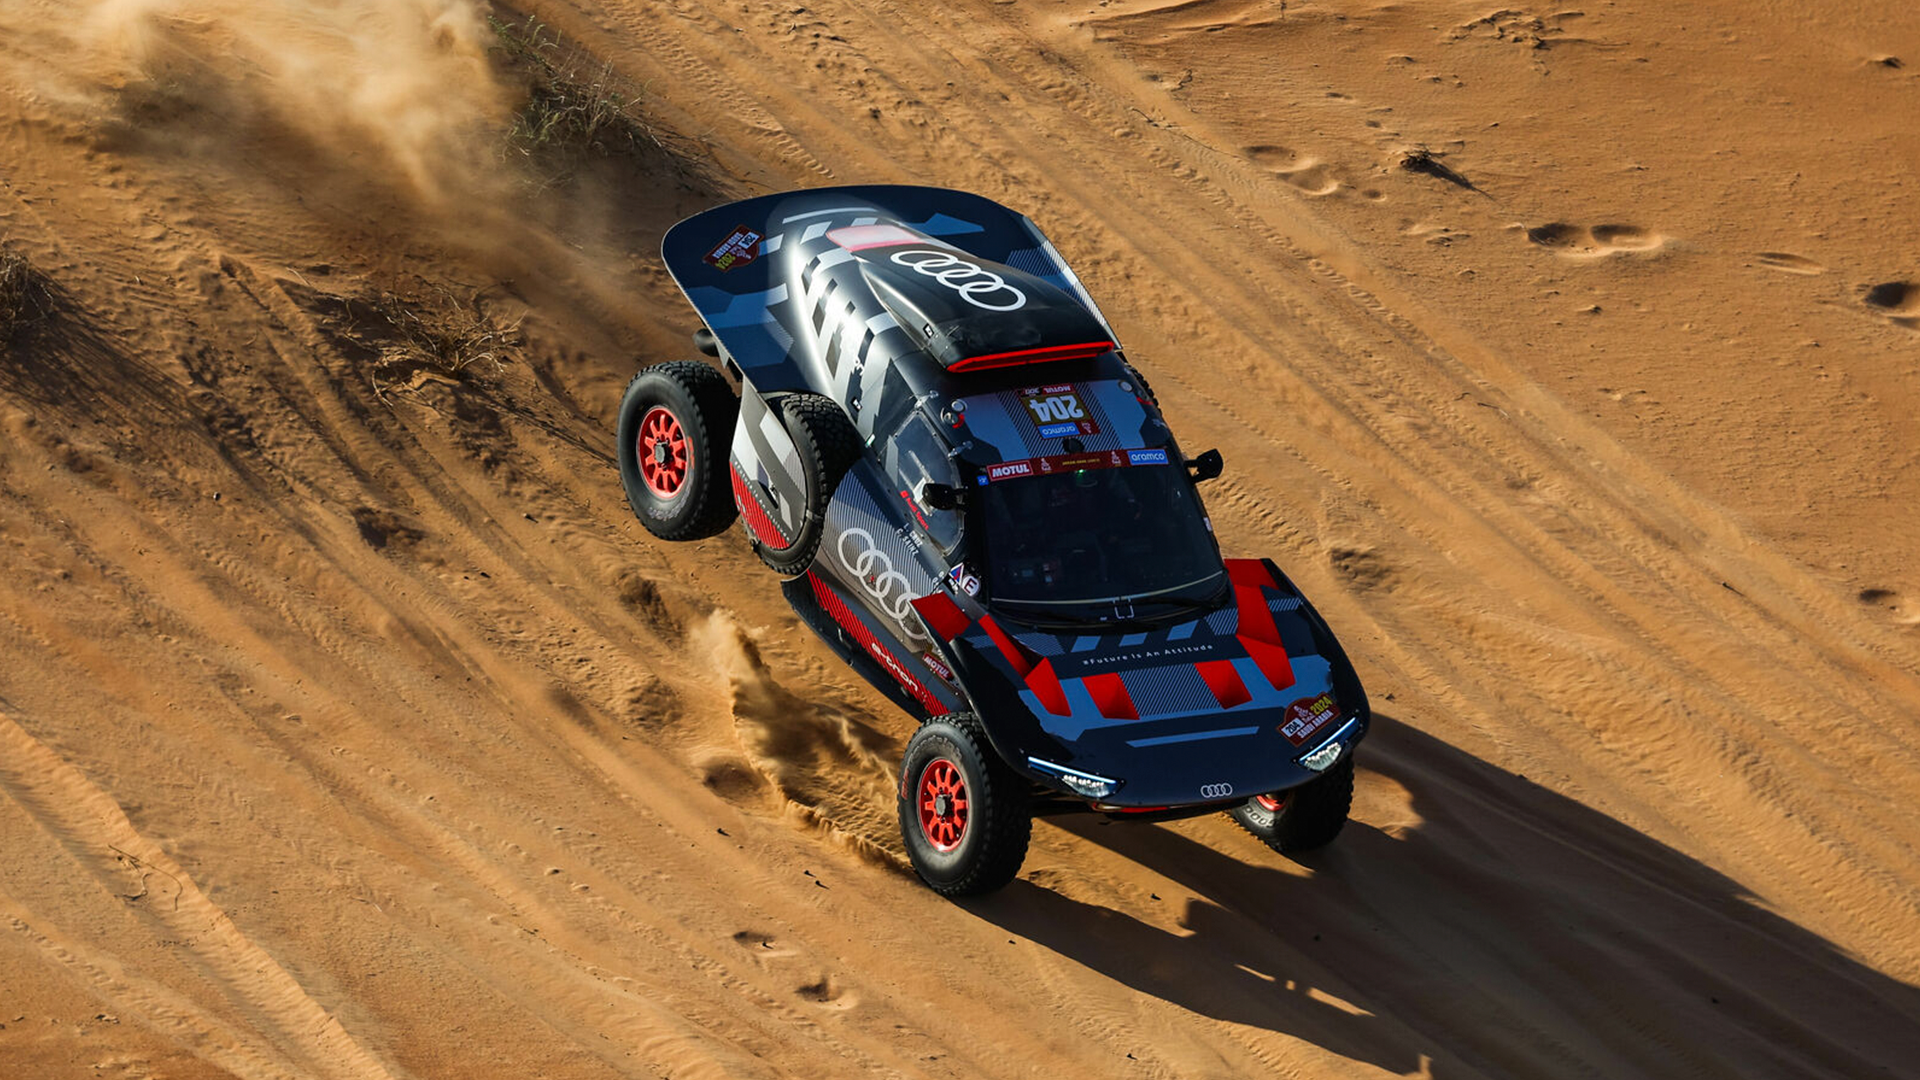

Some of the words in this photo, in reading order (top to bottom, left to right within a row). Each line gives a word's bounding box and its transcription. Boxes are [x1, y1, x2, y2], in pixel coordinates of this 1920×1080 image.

[1044, 385, 1071, 394] MOTUL
[1029, 394, 1084, 422] 204
[1041, 425, 1076, 436] aramco
[1131, 453, 1165, 461] aramco
[992, 463, 1030, 478] MOTUL
[903, 536, 919, 556] SAINZ
[909, 530, 923, 547] CRUZ
[964, 577, 978, 594] E
[1164, 644, 1213, 655] Attitude
[871, 642, 919, 692] e-tron
[923, 656, 949, 678] MOTUL
[1310, 696, 1333, 715] 2024
[1285, 721, 1301, 735] 204
[1297, 722, 1316, 738] SAUDI
